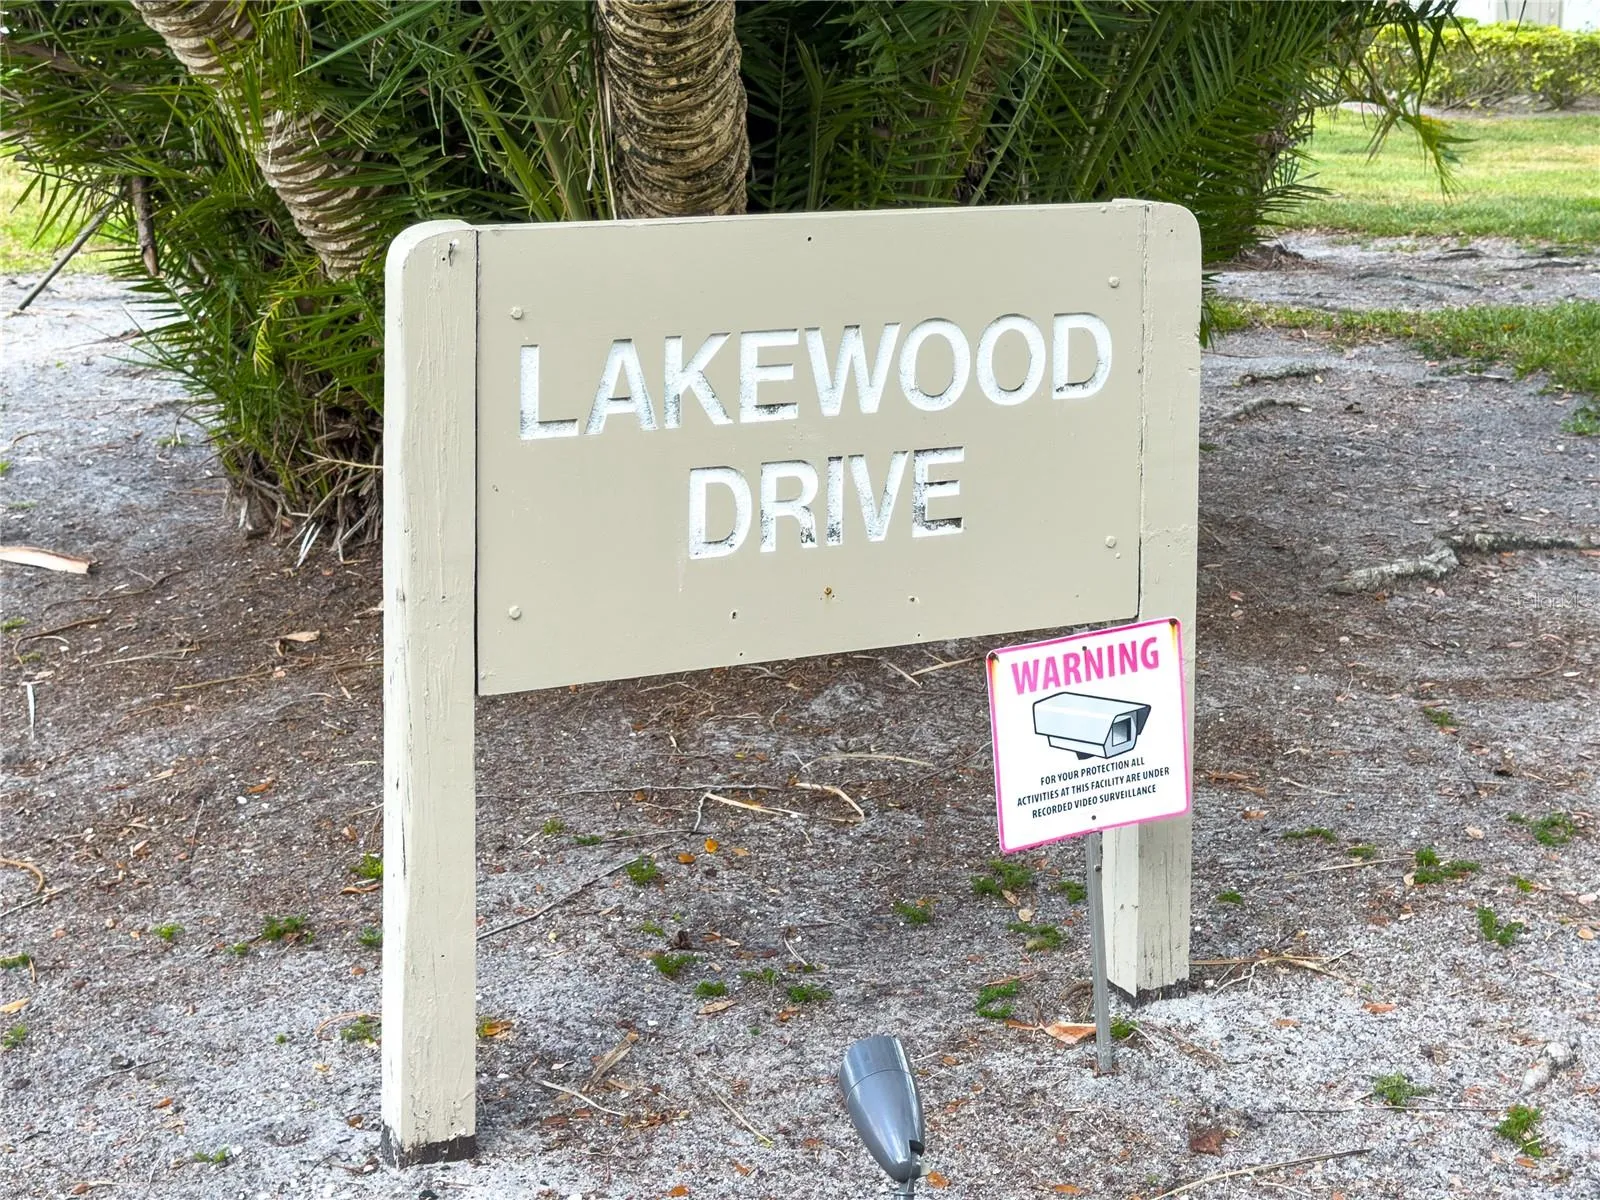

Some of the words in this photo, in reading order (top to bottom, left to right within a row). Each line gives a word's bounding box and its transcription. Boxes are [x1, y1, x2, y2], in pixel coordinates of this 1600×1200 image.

[519, 312, 1113, 440] LAKEWOOD
[688, 446, 965, 560] DRIVE
[1011, 637, 1159, 695] WARNING
[1017, 789, 1059, 807] ACTIVITIES
[1061, 786, 1070, 797] AT
[1072, 783, 1090, 794] THIS
[1091, 776, 1124, 790] FACILITY
[1126, 774, 1141, 783] ARE
[1143, 766, 1170, 780] UNDER
[1040, 776, 1057, 786] FOR
[1058, 770, 1079, 782] YOUR
[1081, 760, 1130, 777] PROTECTION
[1131, 757, 1145, 767] ALL
[1032, 801, 1073, 818] RECORDED
[1074, 796, 1098, 809] VIDEO
[1099, 784, 1157, 804] SURVEILLANCE
